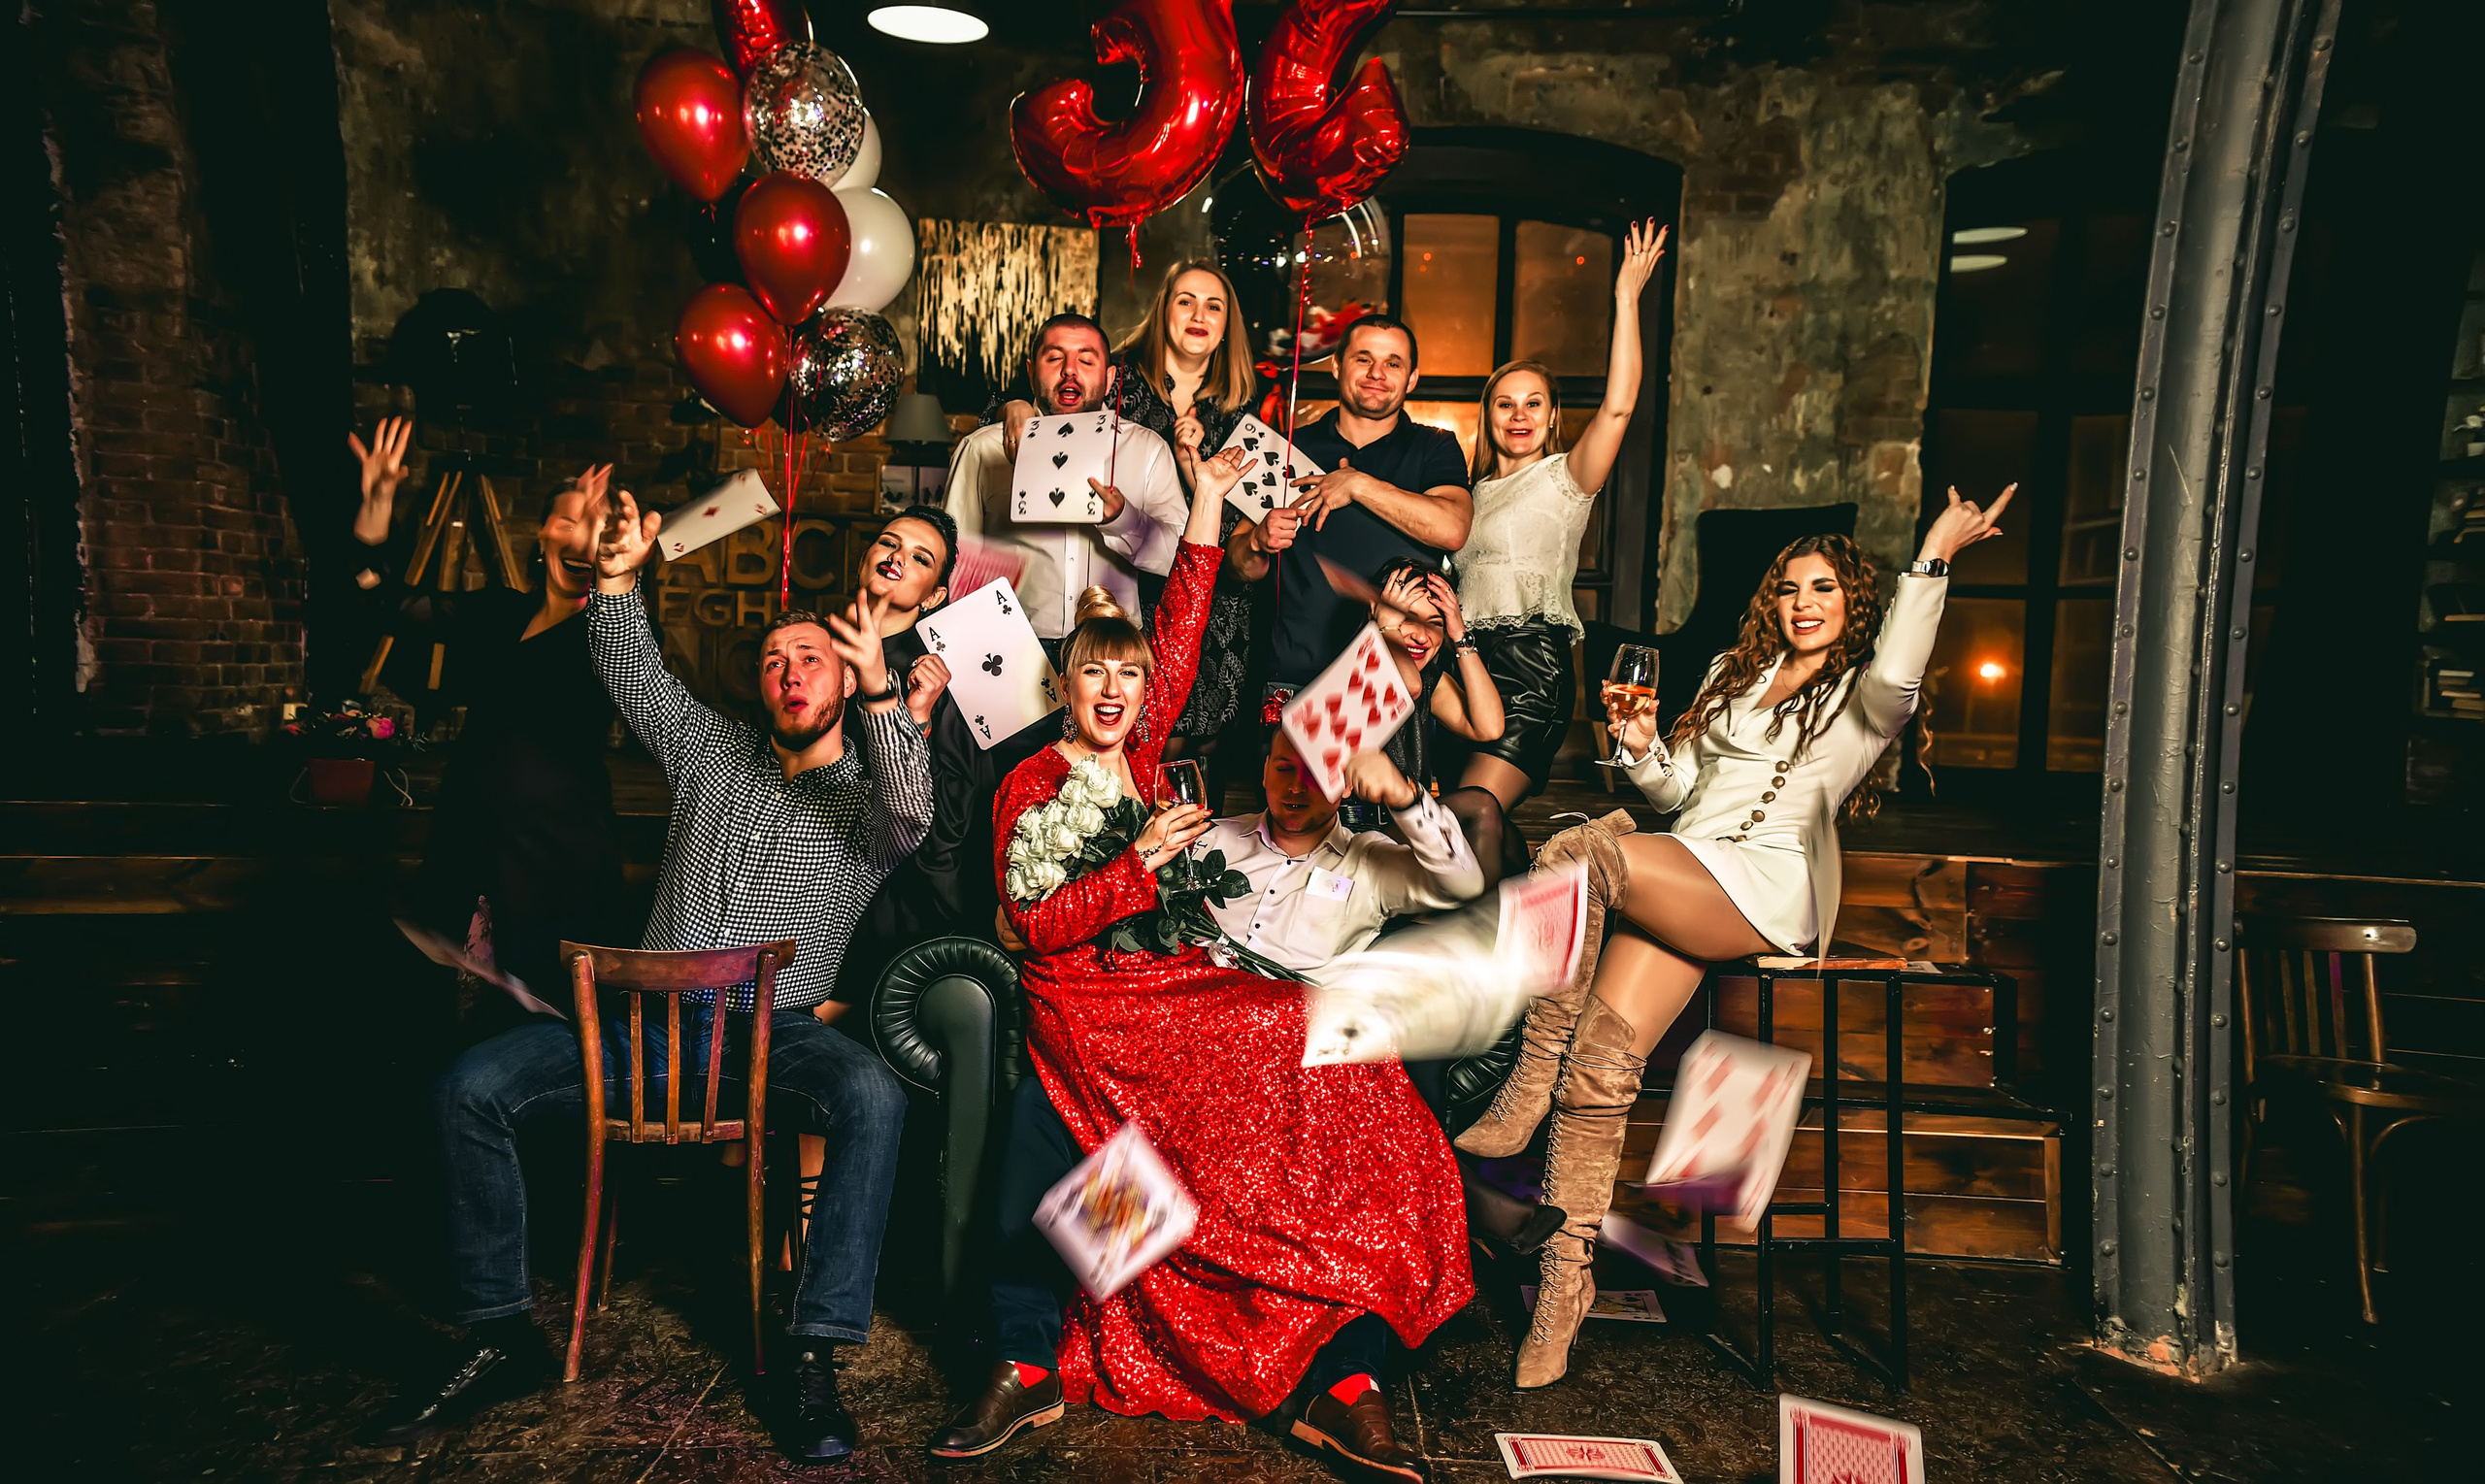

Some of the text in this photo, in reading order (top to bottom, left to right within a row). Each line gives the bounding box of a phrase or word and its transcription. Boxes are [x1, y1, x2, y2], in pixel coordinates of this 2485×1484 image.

[1030, 420, 1041, 431] 3
[1097, 414, 1107, 425] 3
[1018, 501, 1027, 515] 3
[1087, 501, 1096, 515] 3
[656, 518, 879, 585] ABC
[996, 590, 1008, 605] A
[929, 627, 941, 642] A
[1045, 688, 1058, 704] A
[979, 725, 992, 740] A
